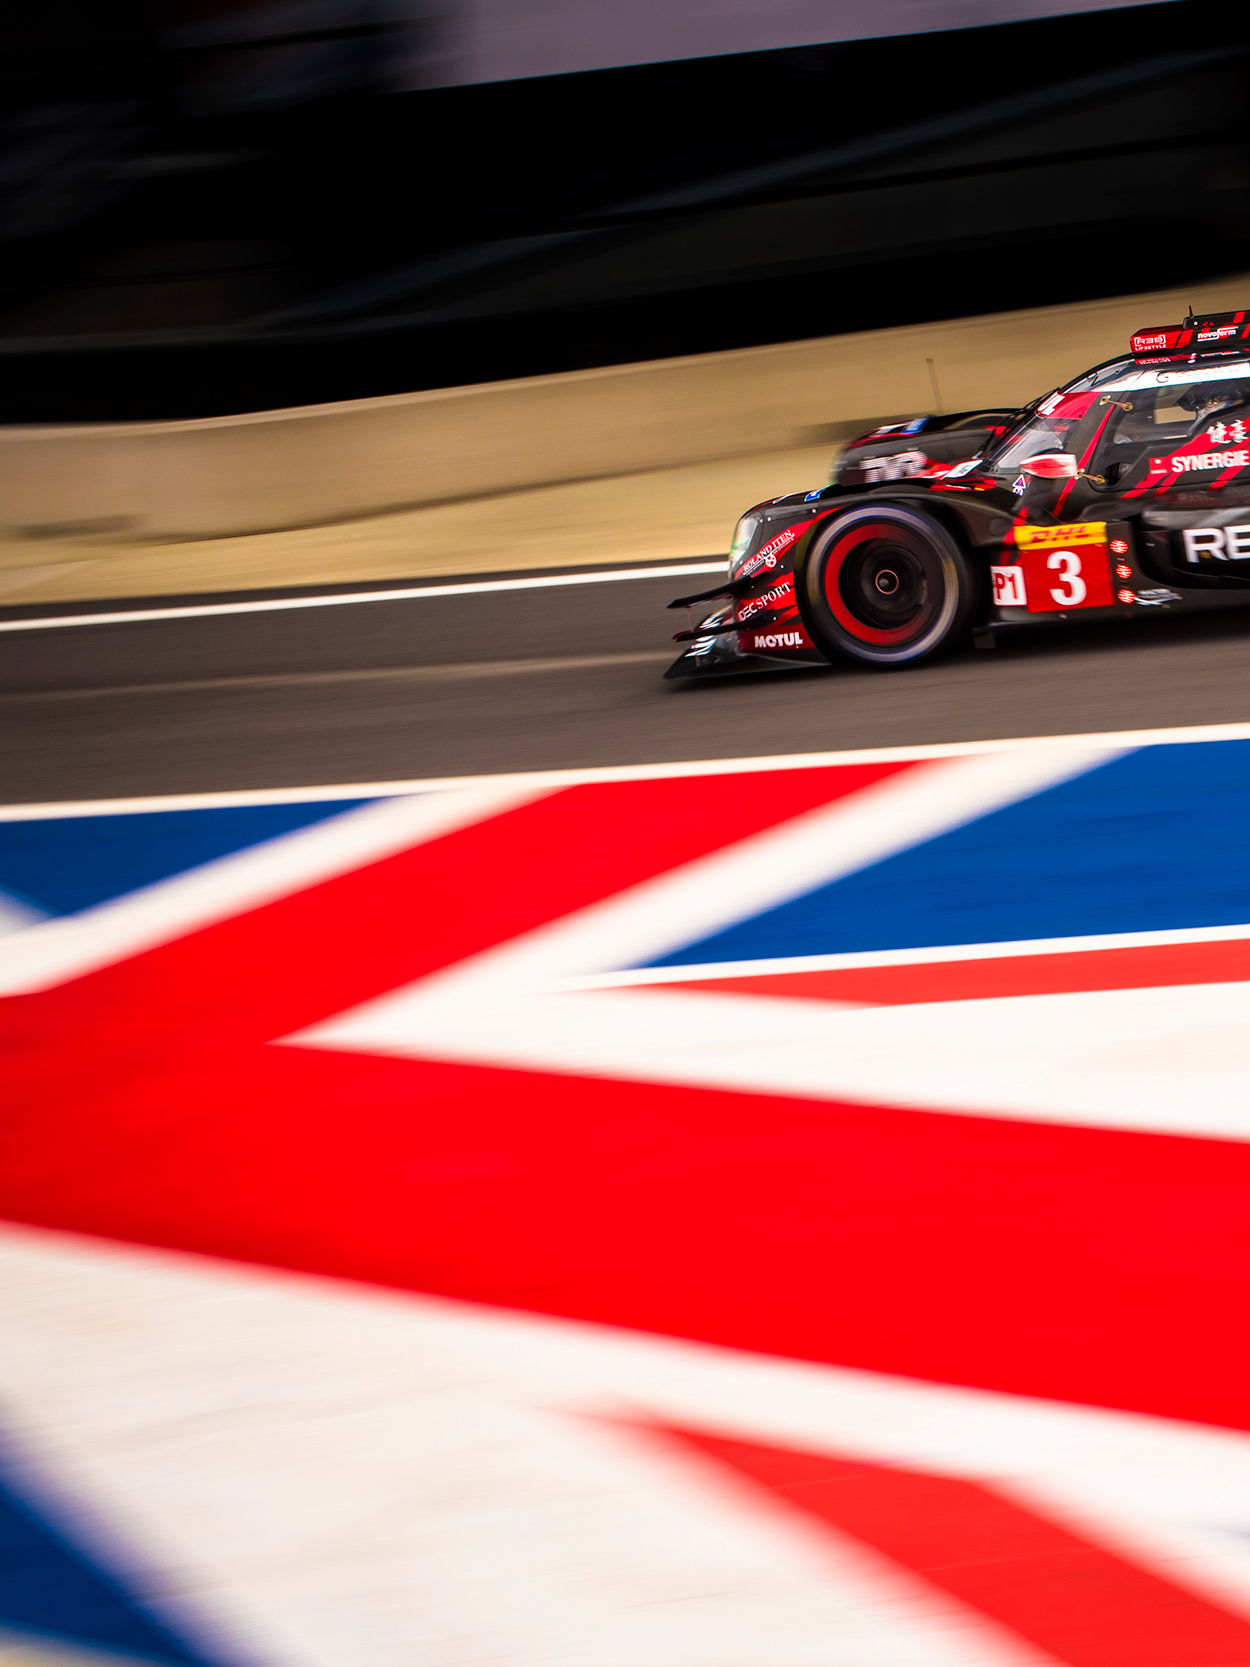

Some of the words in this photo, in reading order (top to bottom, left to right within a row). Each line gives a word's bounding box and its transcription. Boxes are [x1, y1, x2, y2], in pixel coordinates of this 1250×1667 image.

[1197, 327, 1239, 342] novoferm
[1171, 450, 1250, 473] SYNERGIE
[771, 529, 793, 549] ITEN
[994, 572, 1019, 601] P1
[1046, 551, 1088, 606] 3
[755, 581, 792, 610] SPORT
[754, 631, 804, 648] MOTUL
